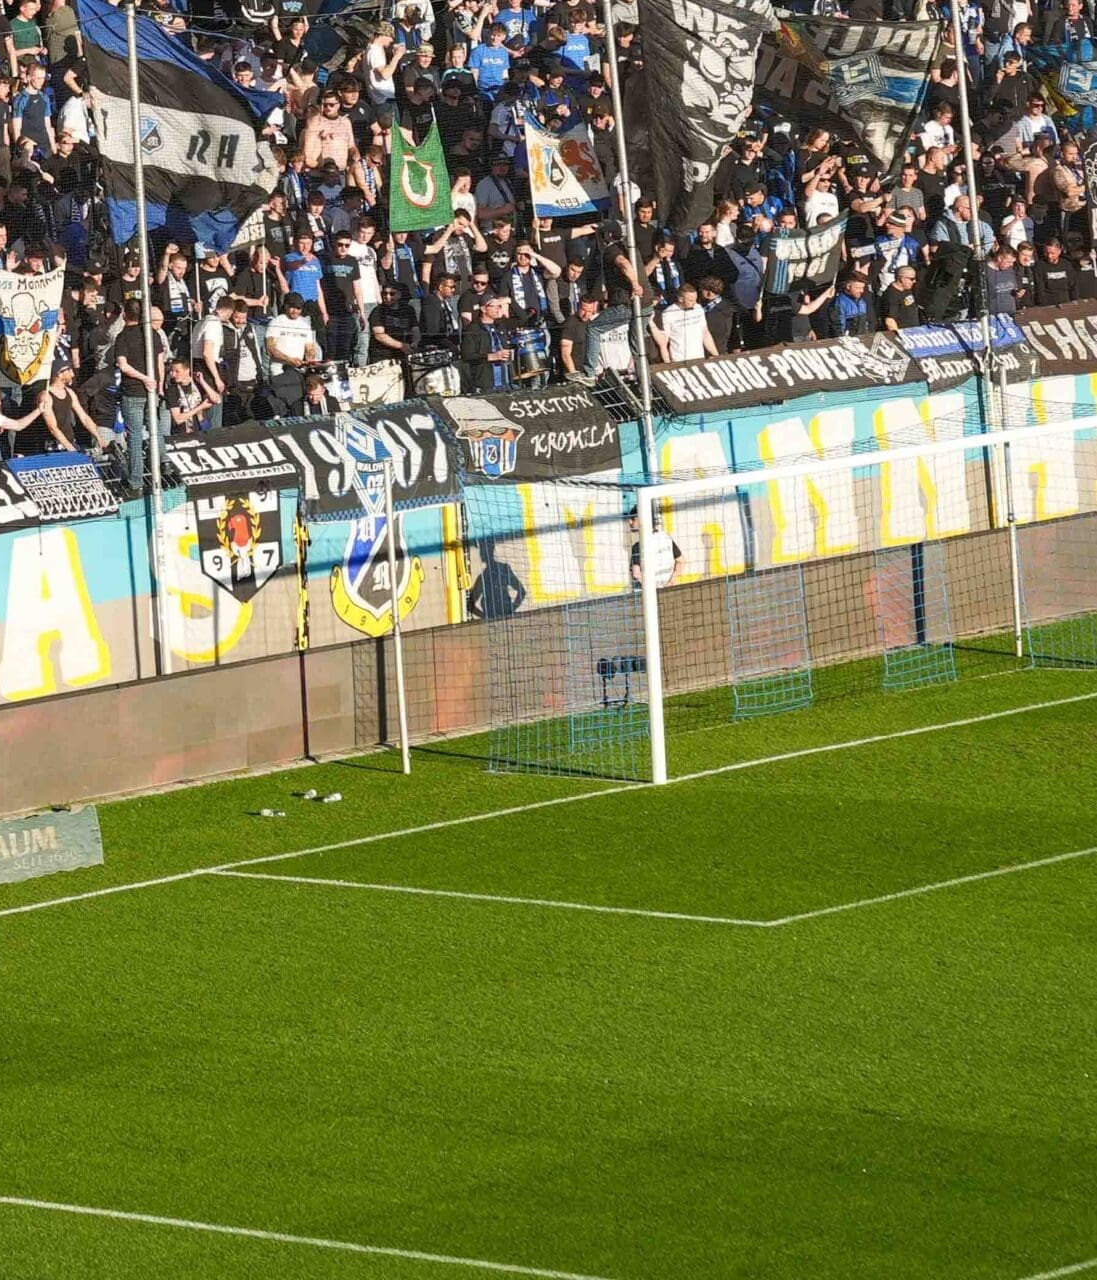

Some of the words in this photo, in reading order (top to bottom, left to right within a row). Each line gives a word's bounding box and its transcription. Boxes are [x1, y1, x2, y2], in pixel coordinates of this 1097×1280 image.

[509, 390, 594, 419] SEKTION
[277, 412, 449, 499] 1907
[356, 461, 386, 472] WALDH
[516, 376, 1097, 607] MANNH
